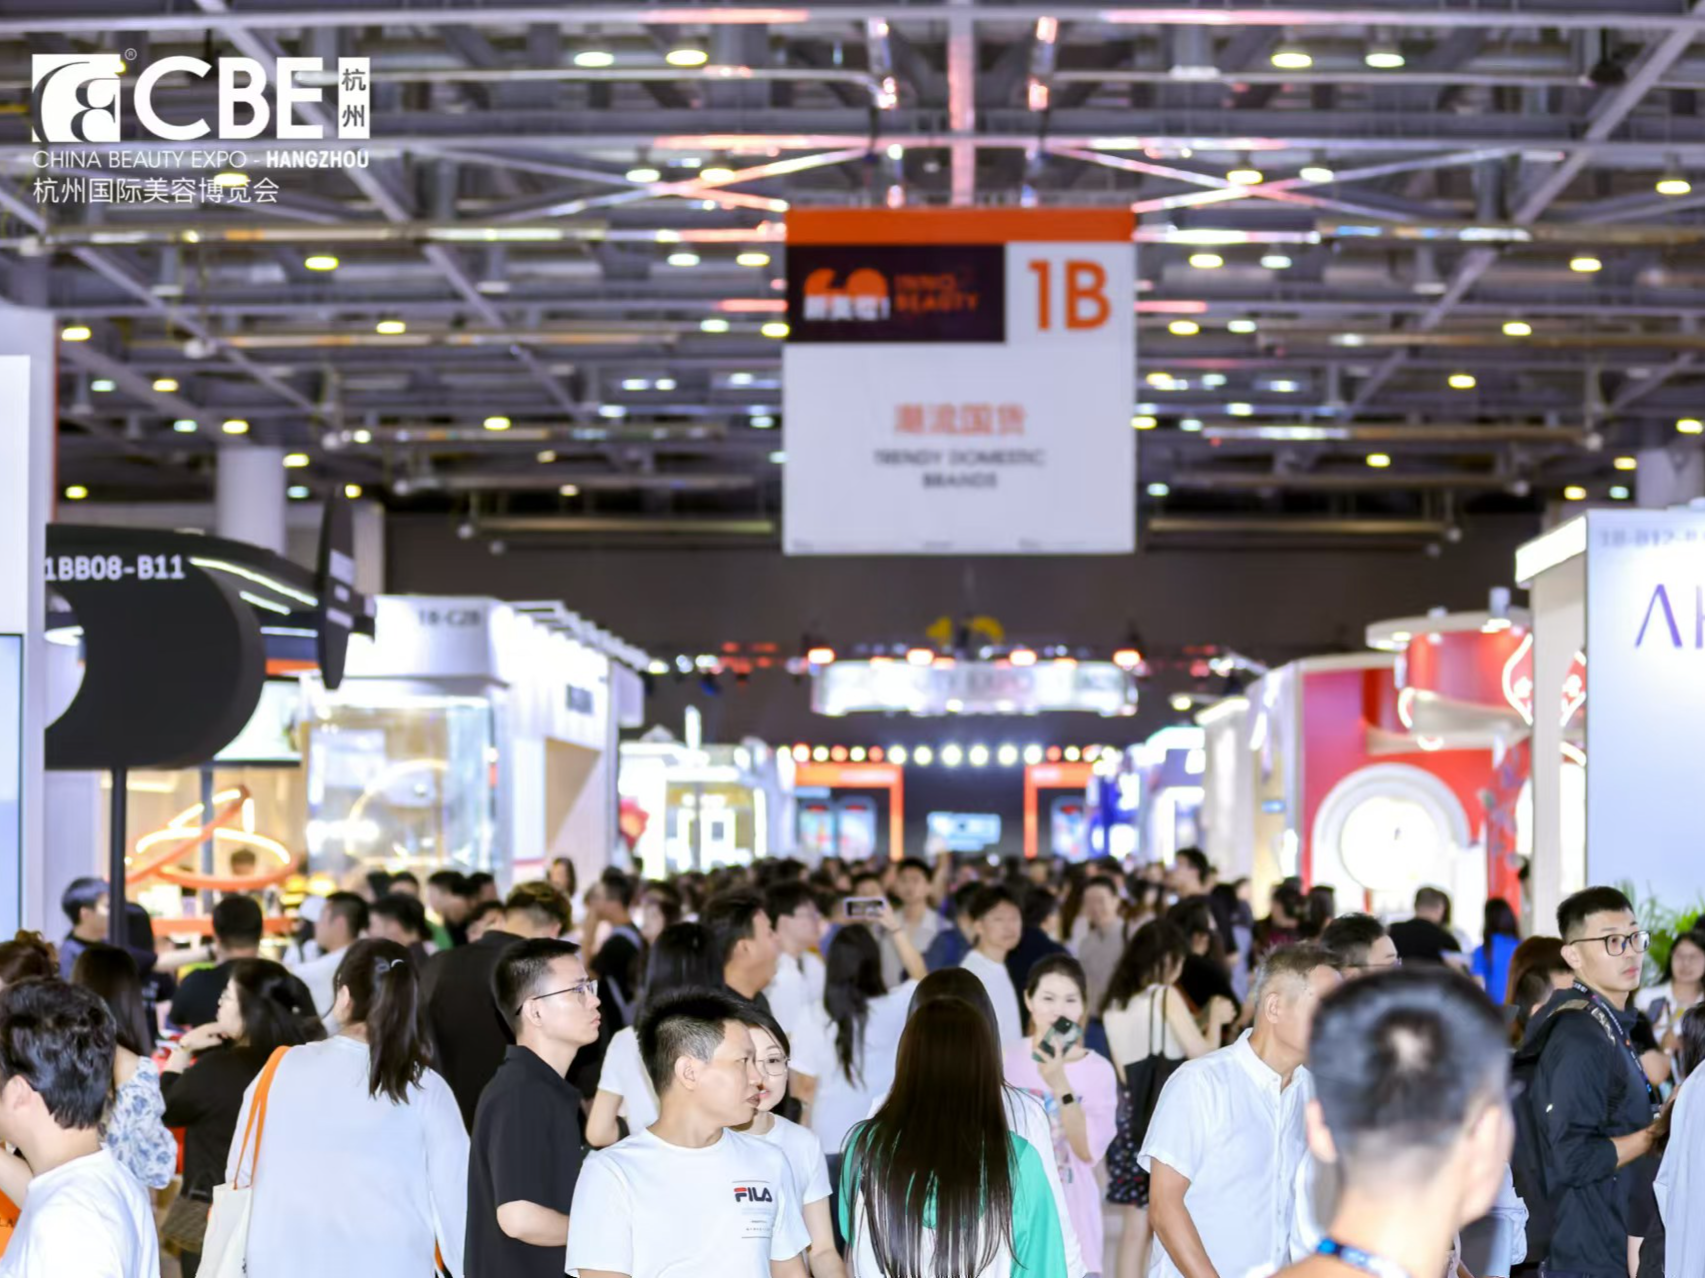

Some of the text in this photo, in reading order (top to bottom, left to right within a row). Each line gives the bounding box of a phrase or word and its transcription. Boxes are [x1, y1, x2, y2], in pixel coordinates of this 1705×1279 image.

[1028, 259, 1112, 332] 1B
[874, 449, 1046, 467] TRENDY DOMESTIC
[922, 472, 997, 489] BRANDS
[733, 1186, 773, 1202] FILA
